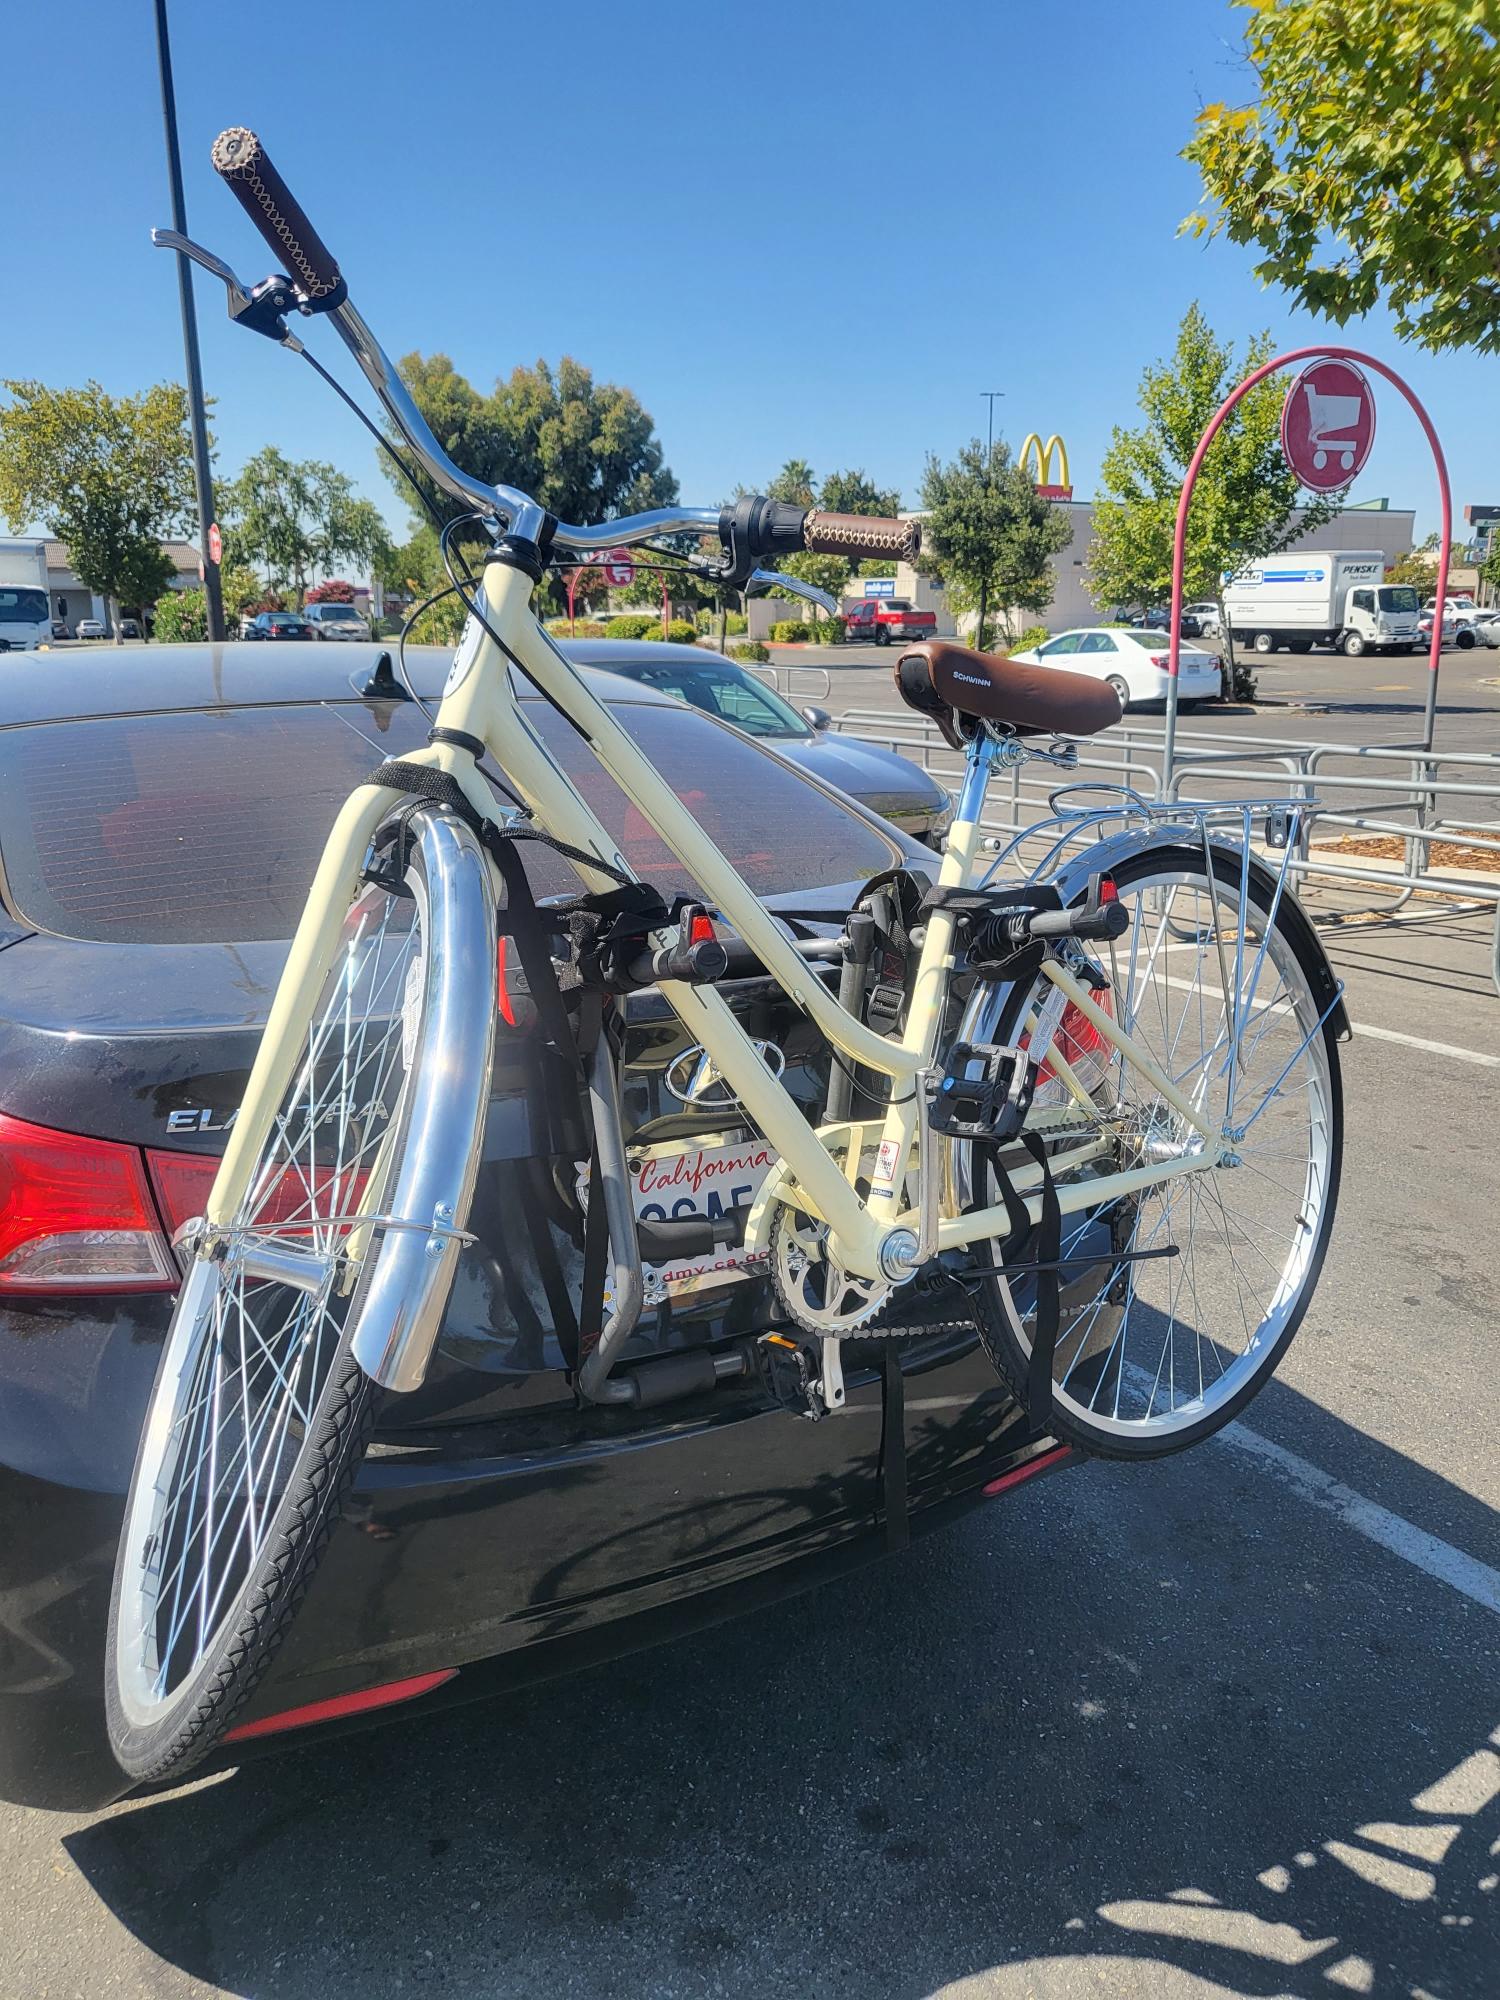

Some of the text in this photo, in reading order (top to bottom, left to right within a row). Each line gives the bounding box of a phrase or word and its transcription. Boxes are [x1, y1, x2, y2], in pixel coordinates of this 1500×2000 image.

[1343, 564, 1379, 574] PENSKE
[952, 671, 992, 687] SCHWINN
[638, 1144, 775, 1194] California
[662, 1250, 770, 1283] dmv.ca.go
